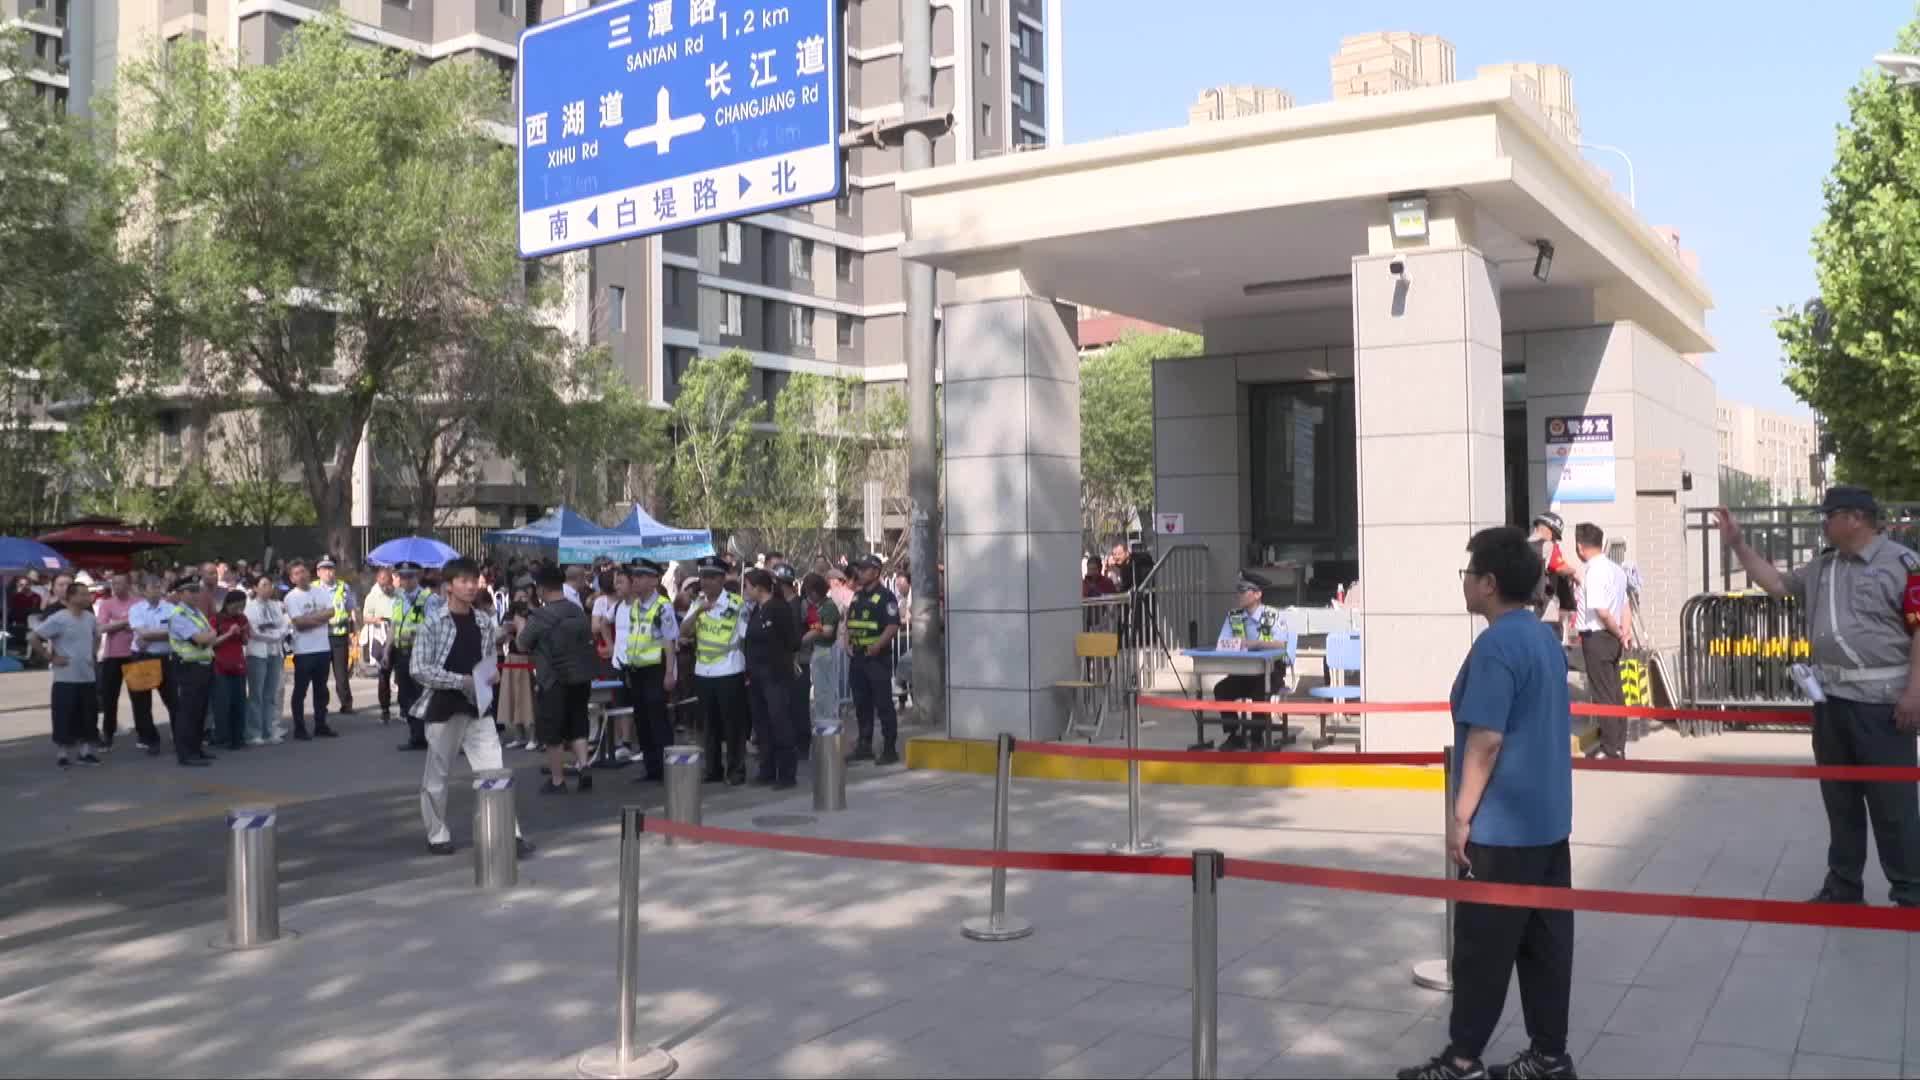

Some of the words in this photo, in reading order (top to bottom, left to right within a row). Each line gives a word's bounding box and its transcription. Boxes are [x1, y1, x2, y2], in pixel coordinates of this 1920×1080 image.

[608, 0, 715, 49] 三潭路
[719, 11, 757, 40] 1.2
[762, 7, 790, 30] km
[626, 45, 677, 72] SANTAN
[684, 35, 704, 57] Rd
[705, 34, 825, 100] 长江道
[525, 90, 624, 148] 西湖道
[714, 95, 795, 126] CHANGJIANG
[801, 84, 819, 106] Rd
[547, 147, 577, 169] XIHU
[582, 141, 599, 159] Rd
[549, 210, 569, 241] 南
[617, 179, 718, 229] 白堤路
[772, 160, 796, 196] 北
